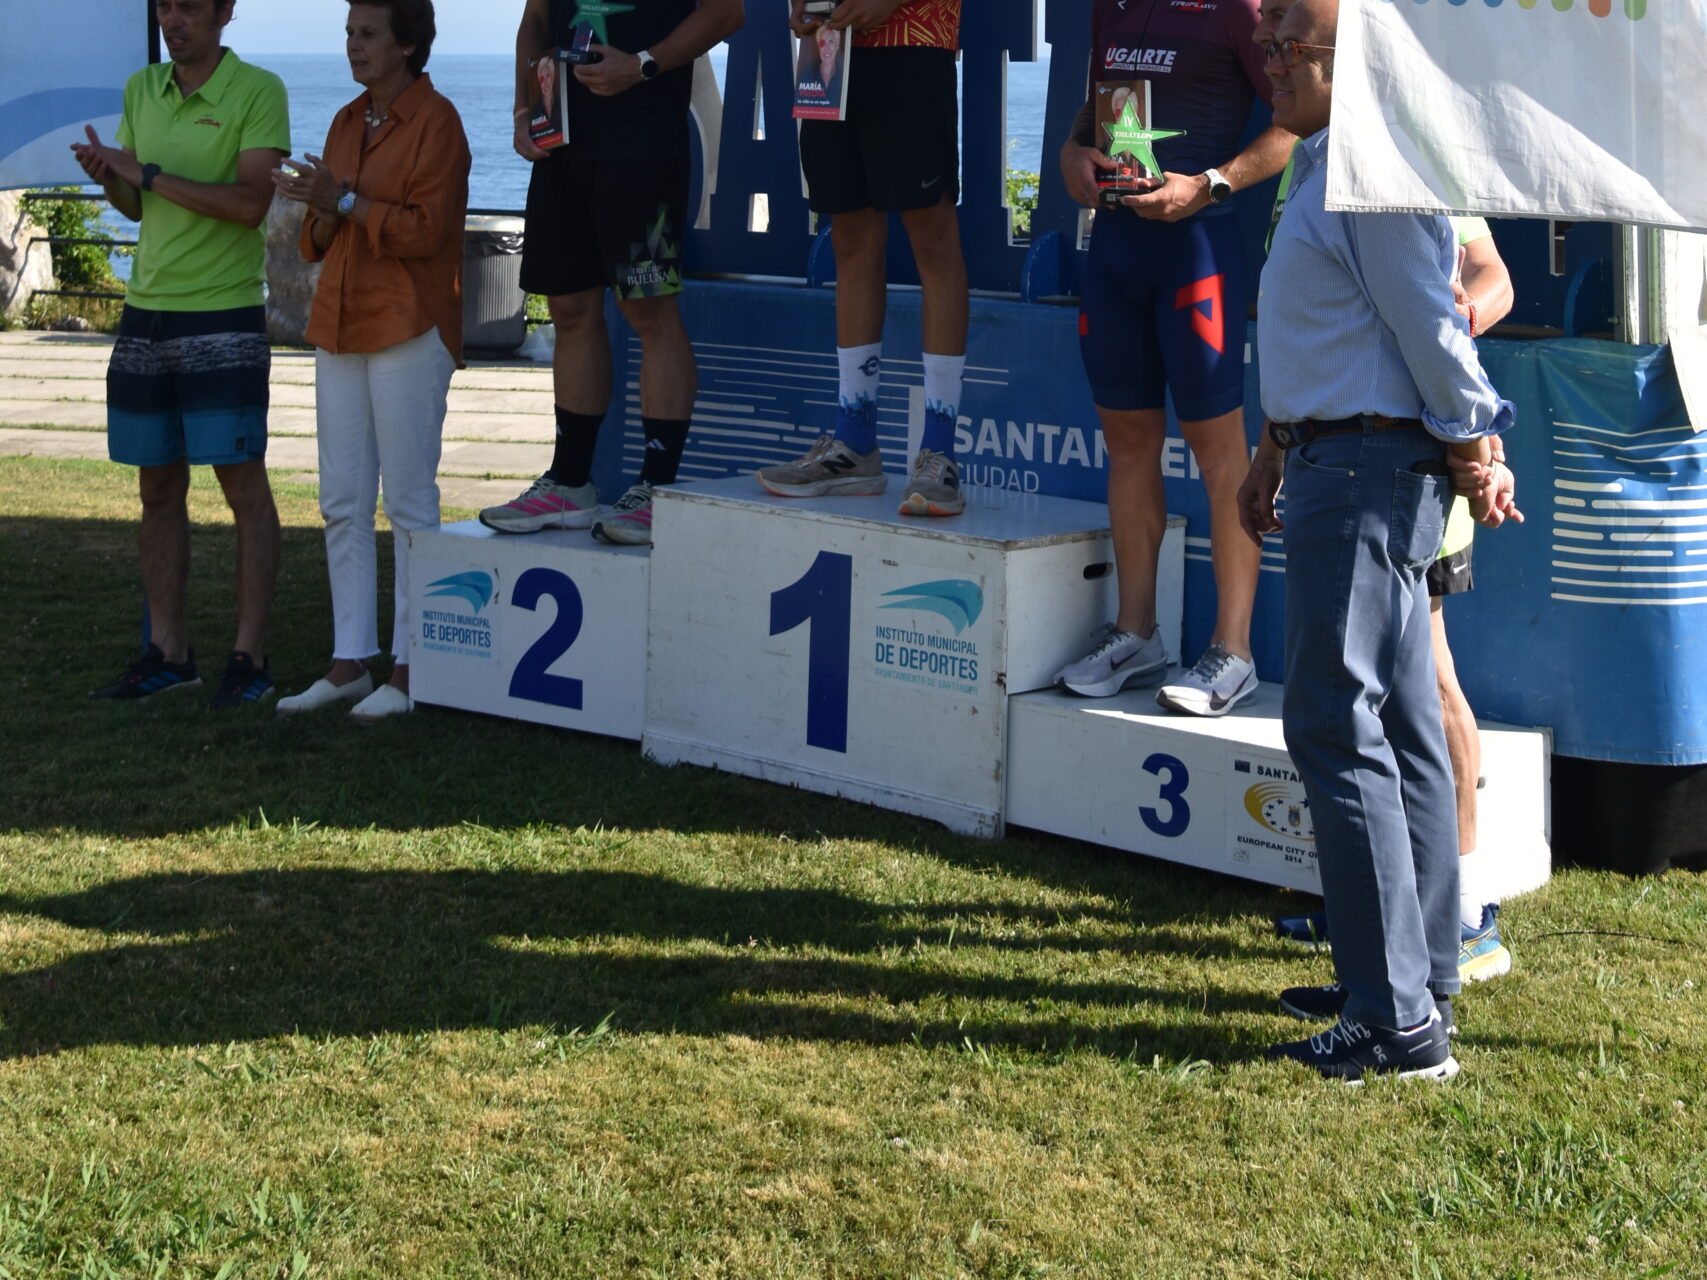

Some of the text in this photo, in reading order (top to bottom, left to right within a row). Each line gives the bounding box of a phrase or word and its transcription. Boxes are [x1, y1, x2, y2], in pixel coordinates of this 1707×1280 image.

[1104, 46, 1177, 66] UGARTE
[799, 81, 822, 91] MARÍA
[1123, 115, 1134, 128] IV
[422, 609, 491, 629] INSTITUTO MUNICIPAL
[422, 623, 492, 649] DE DEPORTES
[508, 566, 584, 711] 2
[875, 625, 979, 656] INSTITUTO MUNICIPAL
[769, 549, 853, 754] 1
[875, 641, 979, 681] DE DEPORTES
[1138, 752, 1191, 838] 3
[1237, 835, 1284, 852] EUROPEAN
[1285, 844, 1306, 857] CITY
